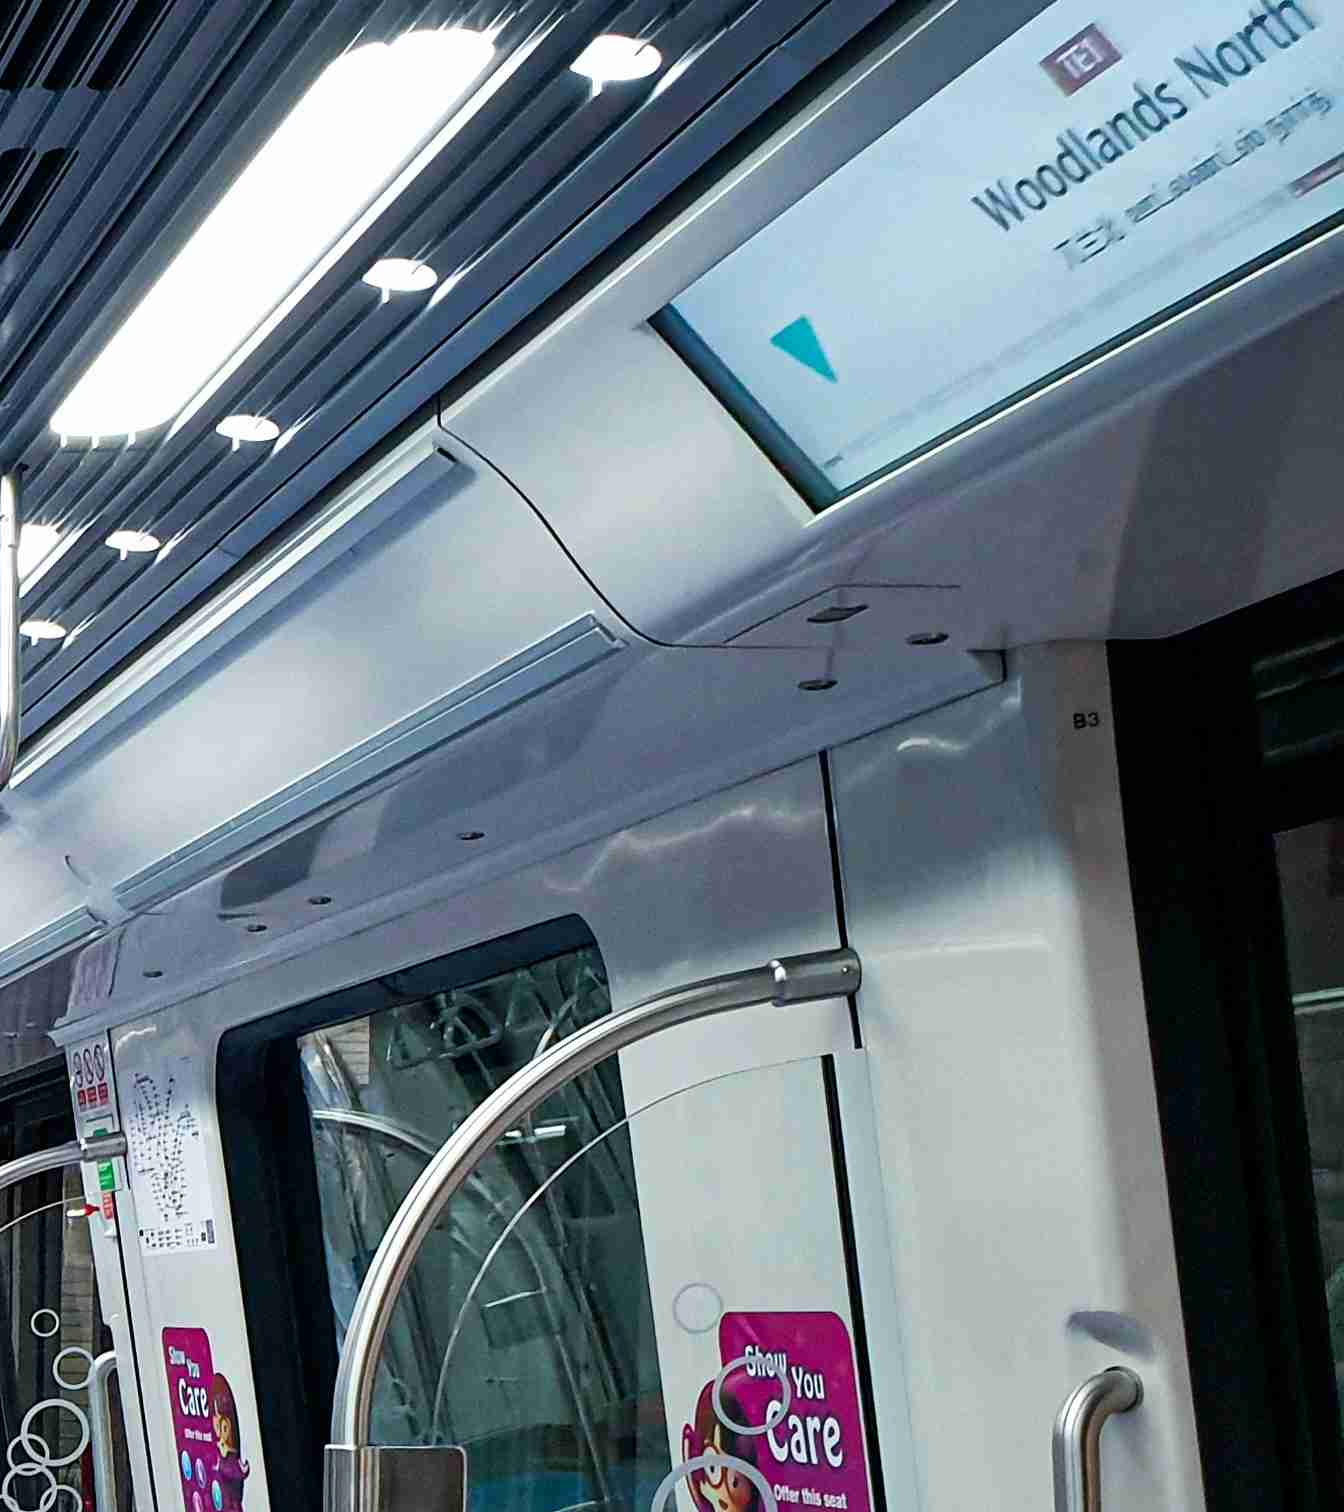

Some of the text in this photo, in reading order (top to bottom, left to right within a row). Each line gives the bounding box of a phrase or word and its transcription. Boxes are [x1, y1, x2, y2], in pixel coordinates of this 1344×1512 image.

[970, 78, 1189, 232] Woodlands
[1173, 0, 1316, 98] North
[1073, 711, 1099, 729] B3
[744, 1345, 825, 1400] Show You
[178, 1377, 209, 1418] Care
[766, 1399, 844, 1468] Care
[774, 1483, 848, 1511] Offer this seat
